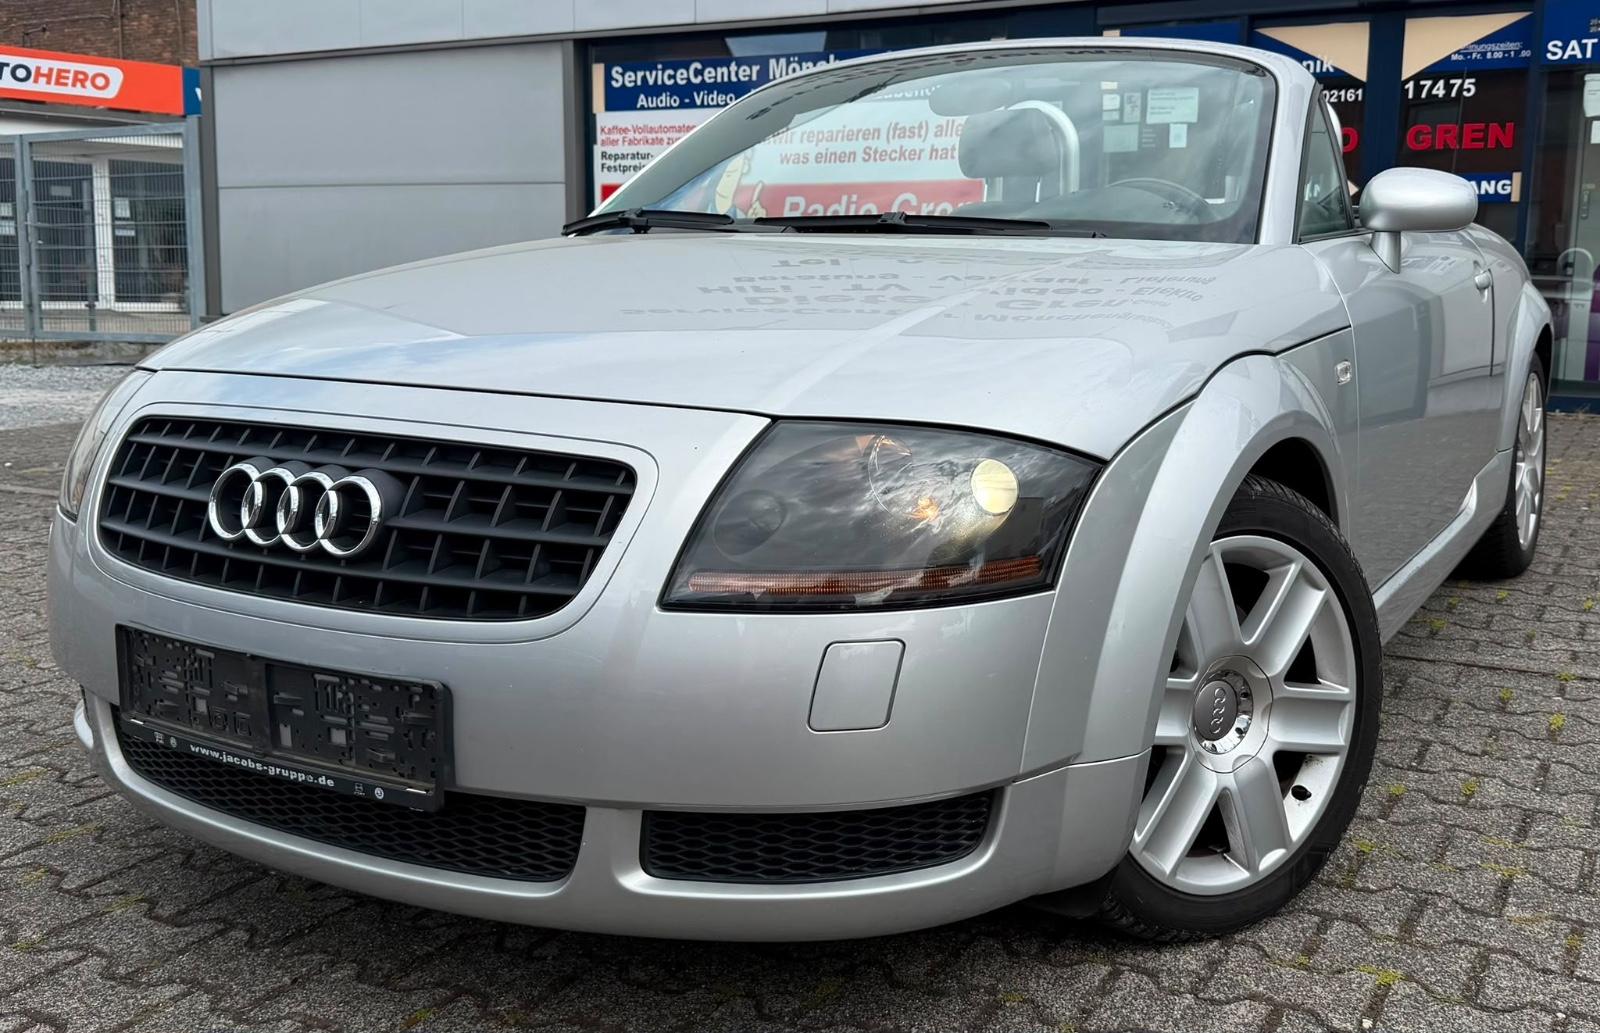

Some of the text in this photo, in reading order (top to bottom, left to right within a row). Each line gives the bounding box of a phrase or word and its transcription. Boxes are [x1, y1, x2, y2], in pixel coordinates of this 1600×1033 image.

[1546, 38, 1599, 60] SAT
[611, 61, 760, 88] ServiceCenter
[637, 93, 680, 109] Audio
[693, 90, 736, 107] Video
[622, 136, 665, 146] Fabrikate
[800, 125, 881, 147] reparieren
[886, 119, 929, 144] (fast)
[1407, 122, 1514, 151] GREN
[600, 151, 654, 162] Reparatur-
[779, 143, 957, 165] was einen Stecker hat
[891, 192, 972, 216] Gre
